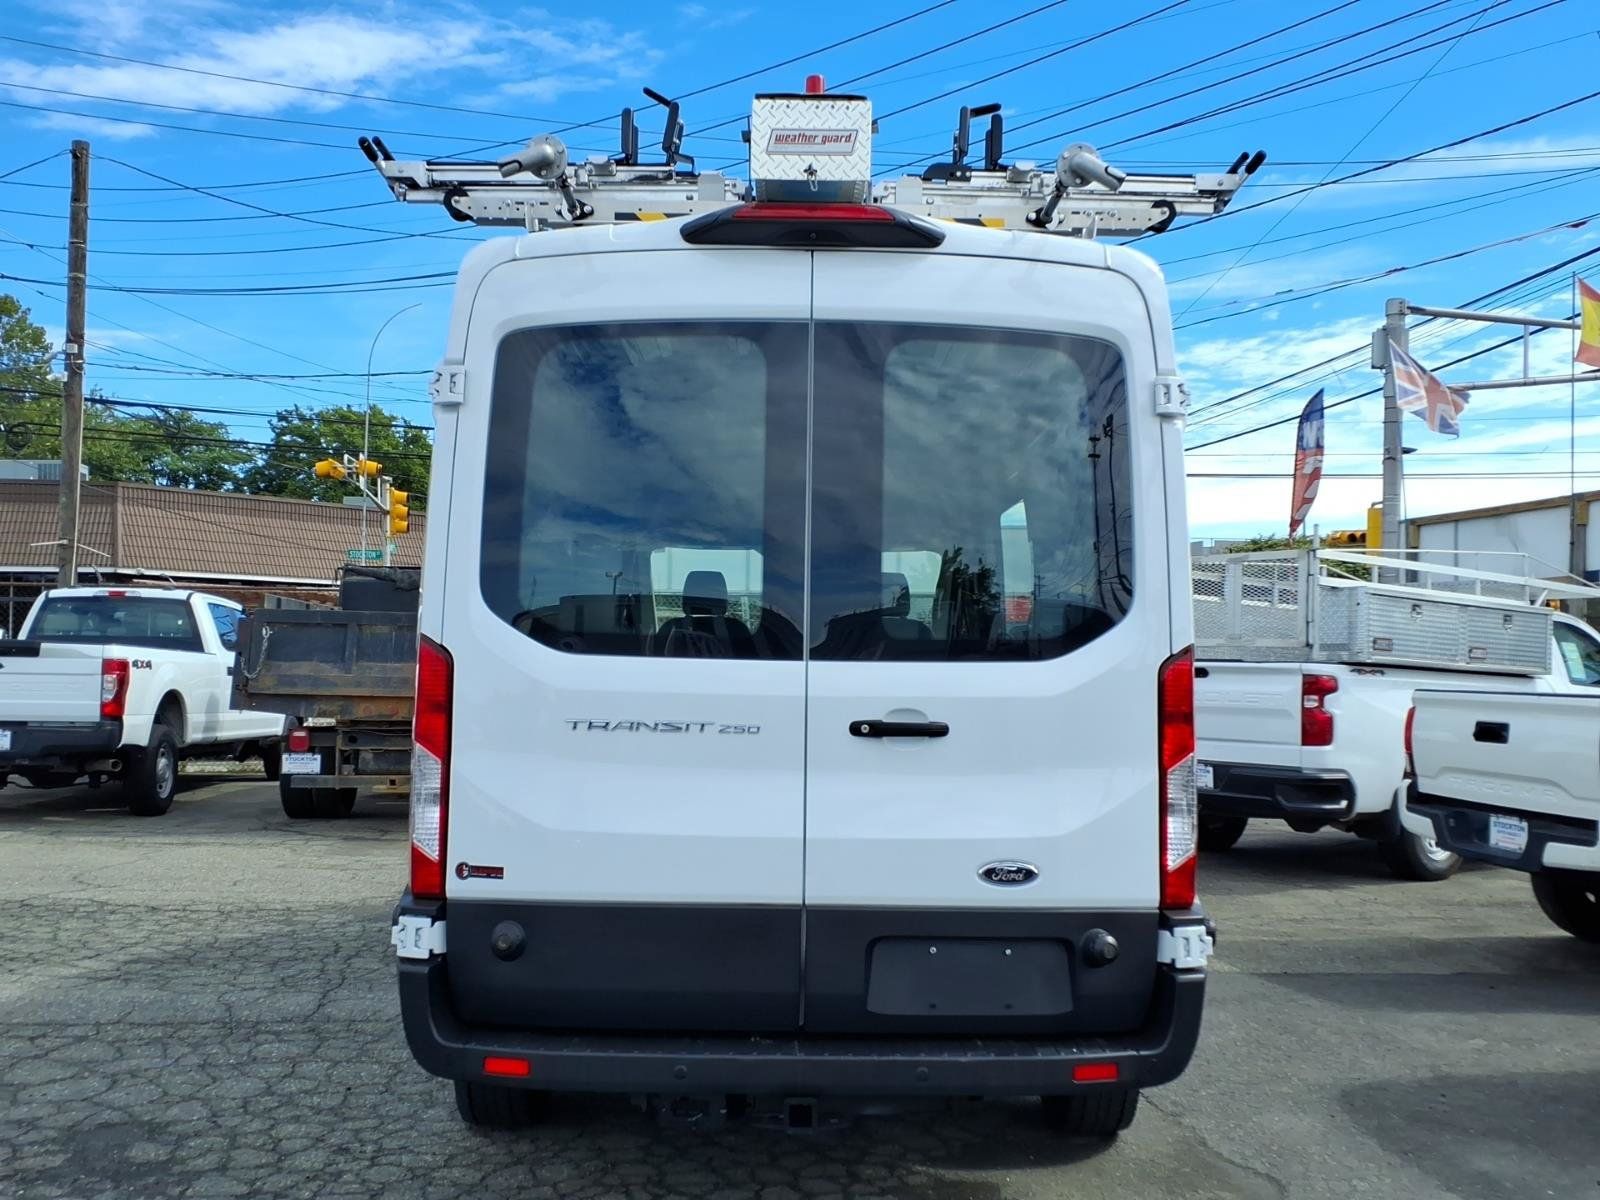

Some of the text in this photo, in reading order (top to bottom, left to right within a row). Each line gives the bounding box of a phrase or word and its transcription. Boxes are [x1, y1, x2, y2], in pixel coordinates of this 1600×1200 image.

[773, 132, 853, 144] weather guard
[564, 718, 761, 735] TRANSIT 250
